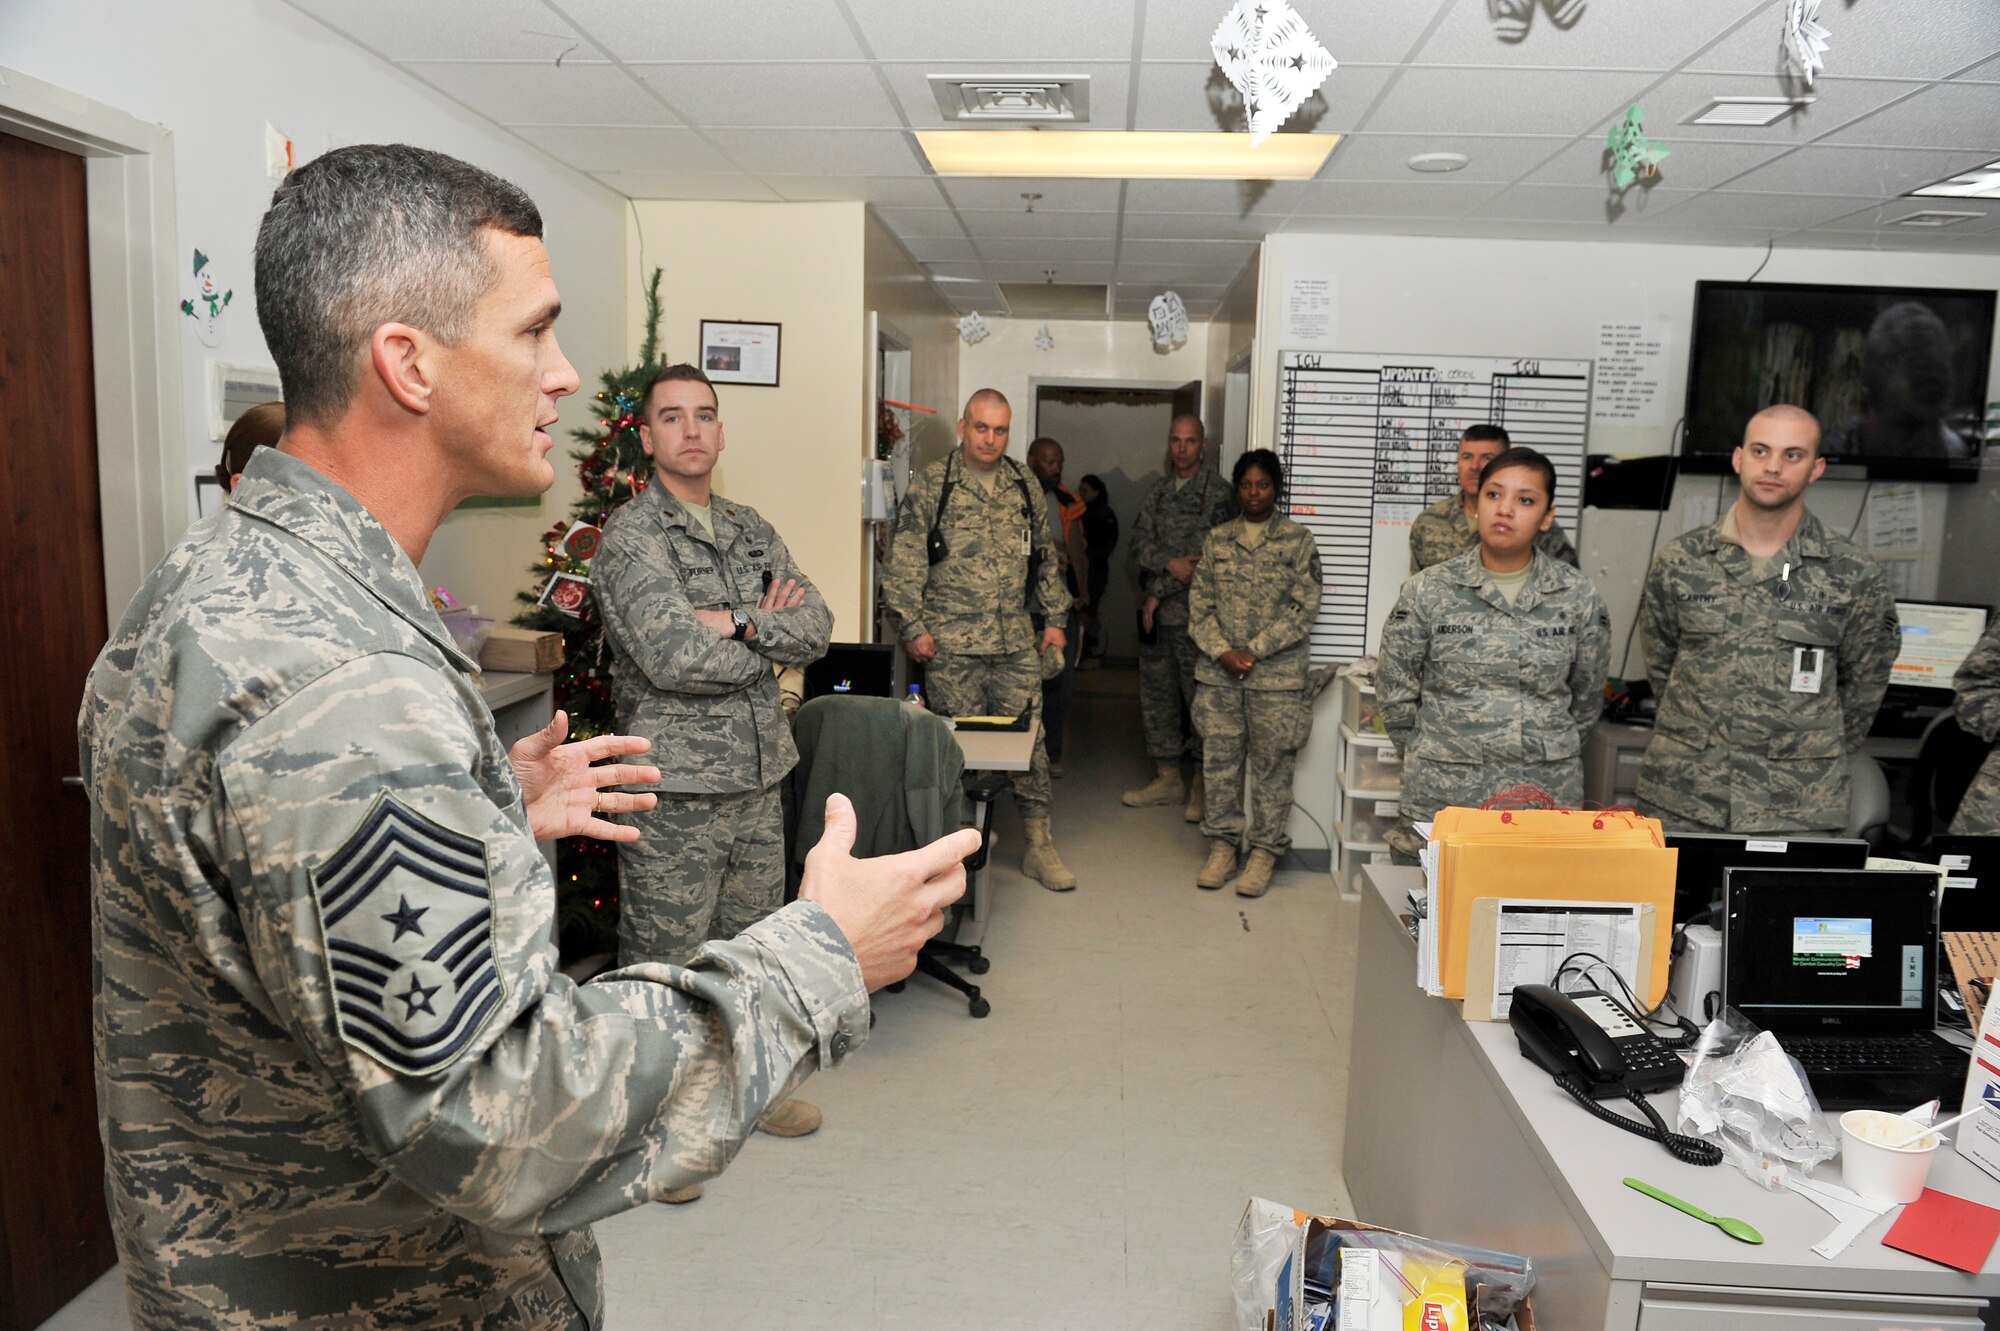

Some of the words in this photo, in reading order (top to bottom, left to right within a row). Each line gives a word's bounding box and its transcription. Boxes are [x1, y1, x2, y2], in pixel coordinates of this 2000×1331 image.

[1296, 353, 1321, 368] ICW
[1512, 358, 1540, 376] ICU
[752, 562, 762, 571] AIR
[1810, 603, 1824, 613] AIR
[1425, 1306, 1441, 1331] Lip
